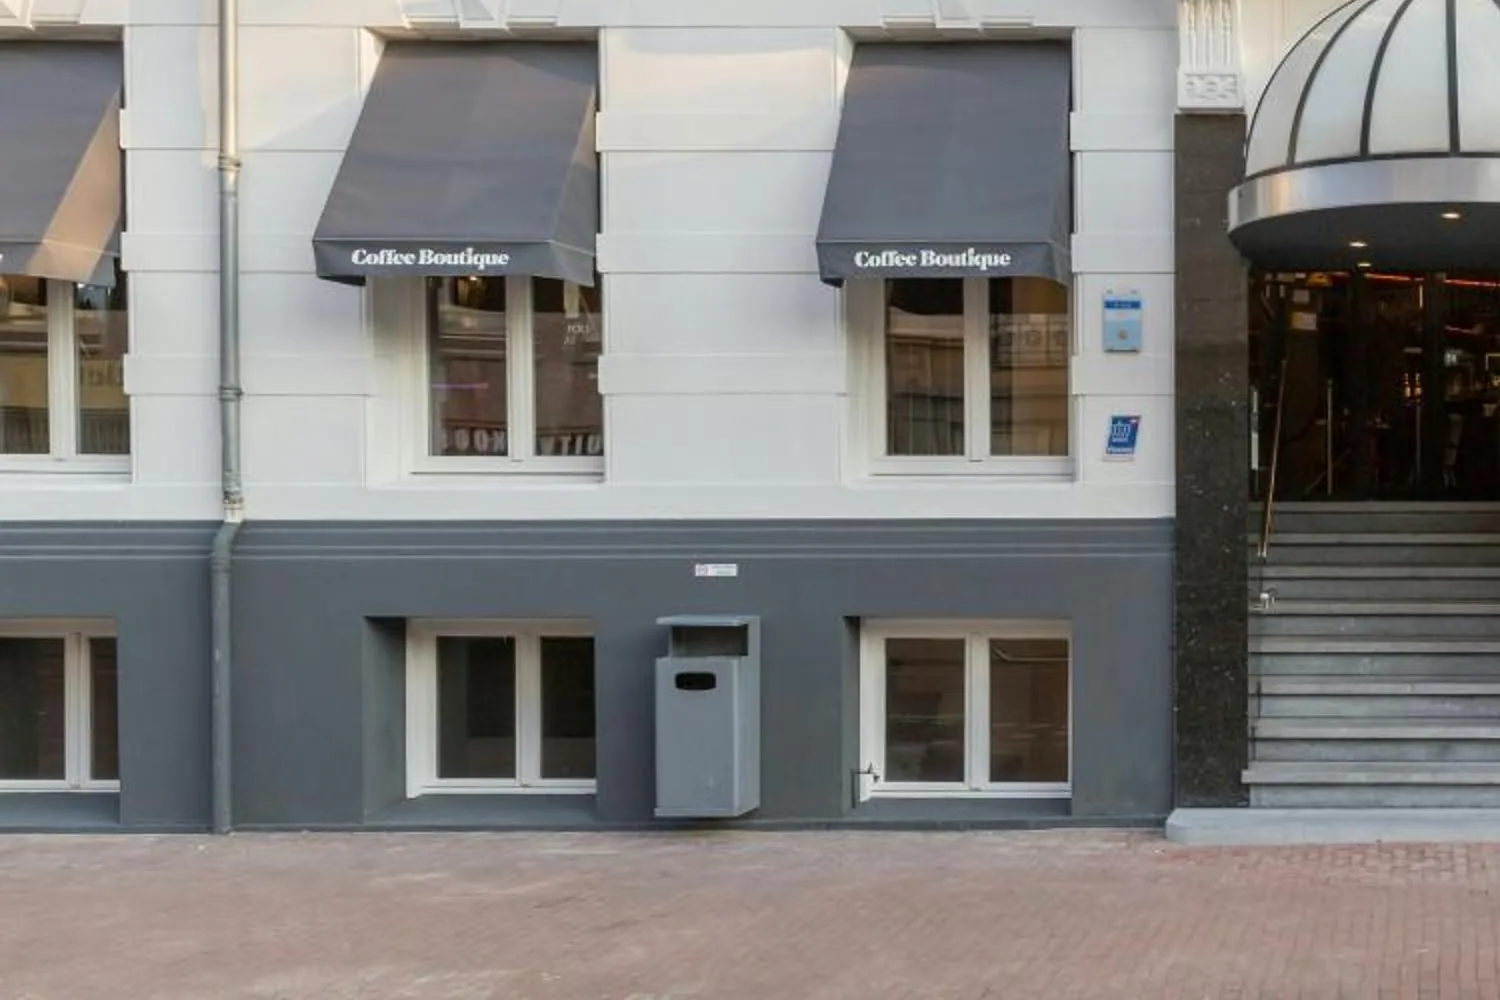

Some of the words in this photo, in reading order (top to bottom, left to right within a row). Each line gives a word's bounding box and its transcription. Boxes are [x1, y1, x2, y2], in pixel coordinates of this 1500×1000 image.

[351, 249, 416, 266] Coffee
[418, 247, 509, 269] Boutique
[854, 251, 917, 268] Coffee
[920, 248, 1011, 271] Boutique
